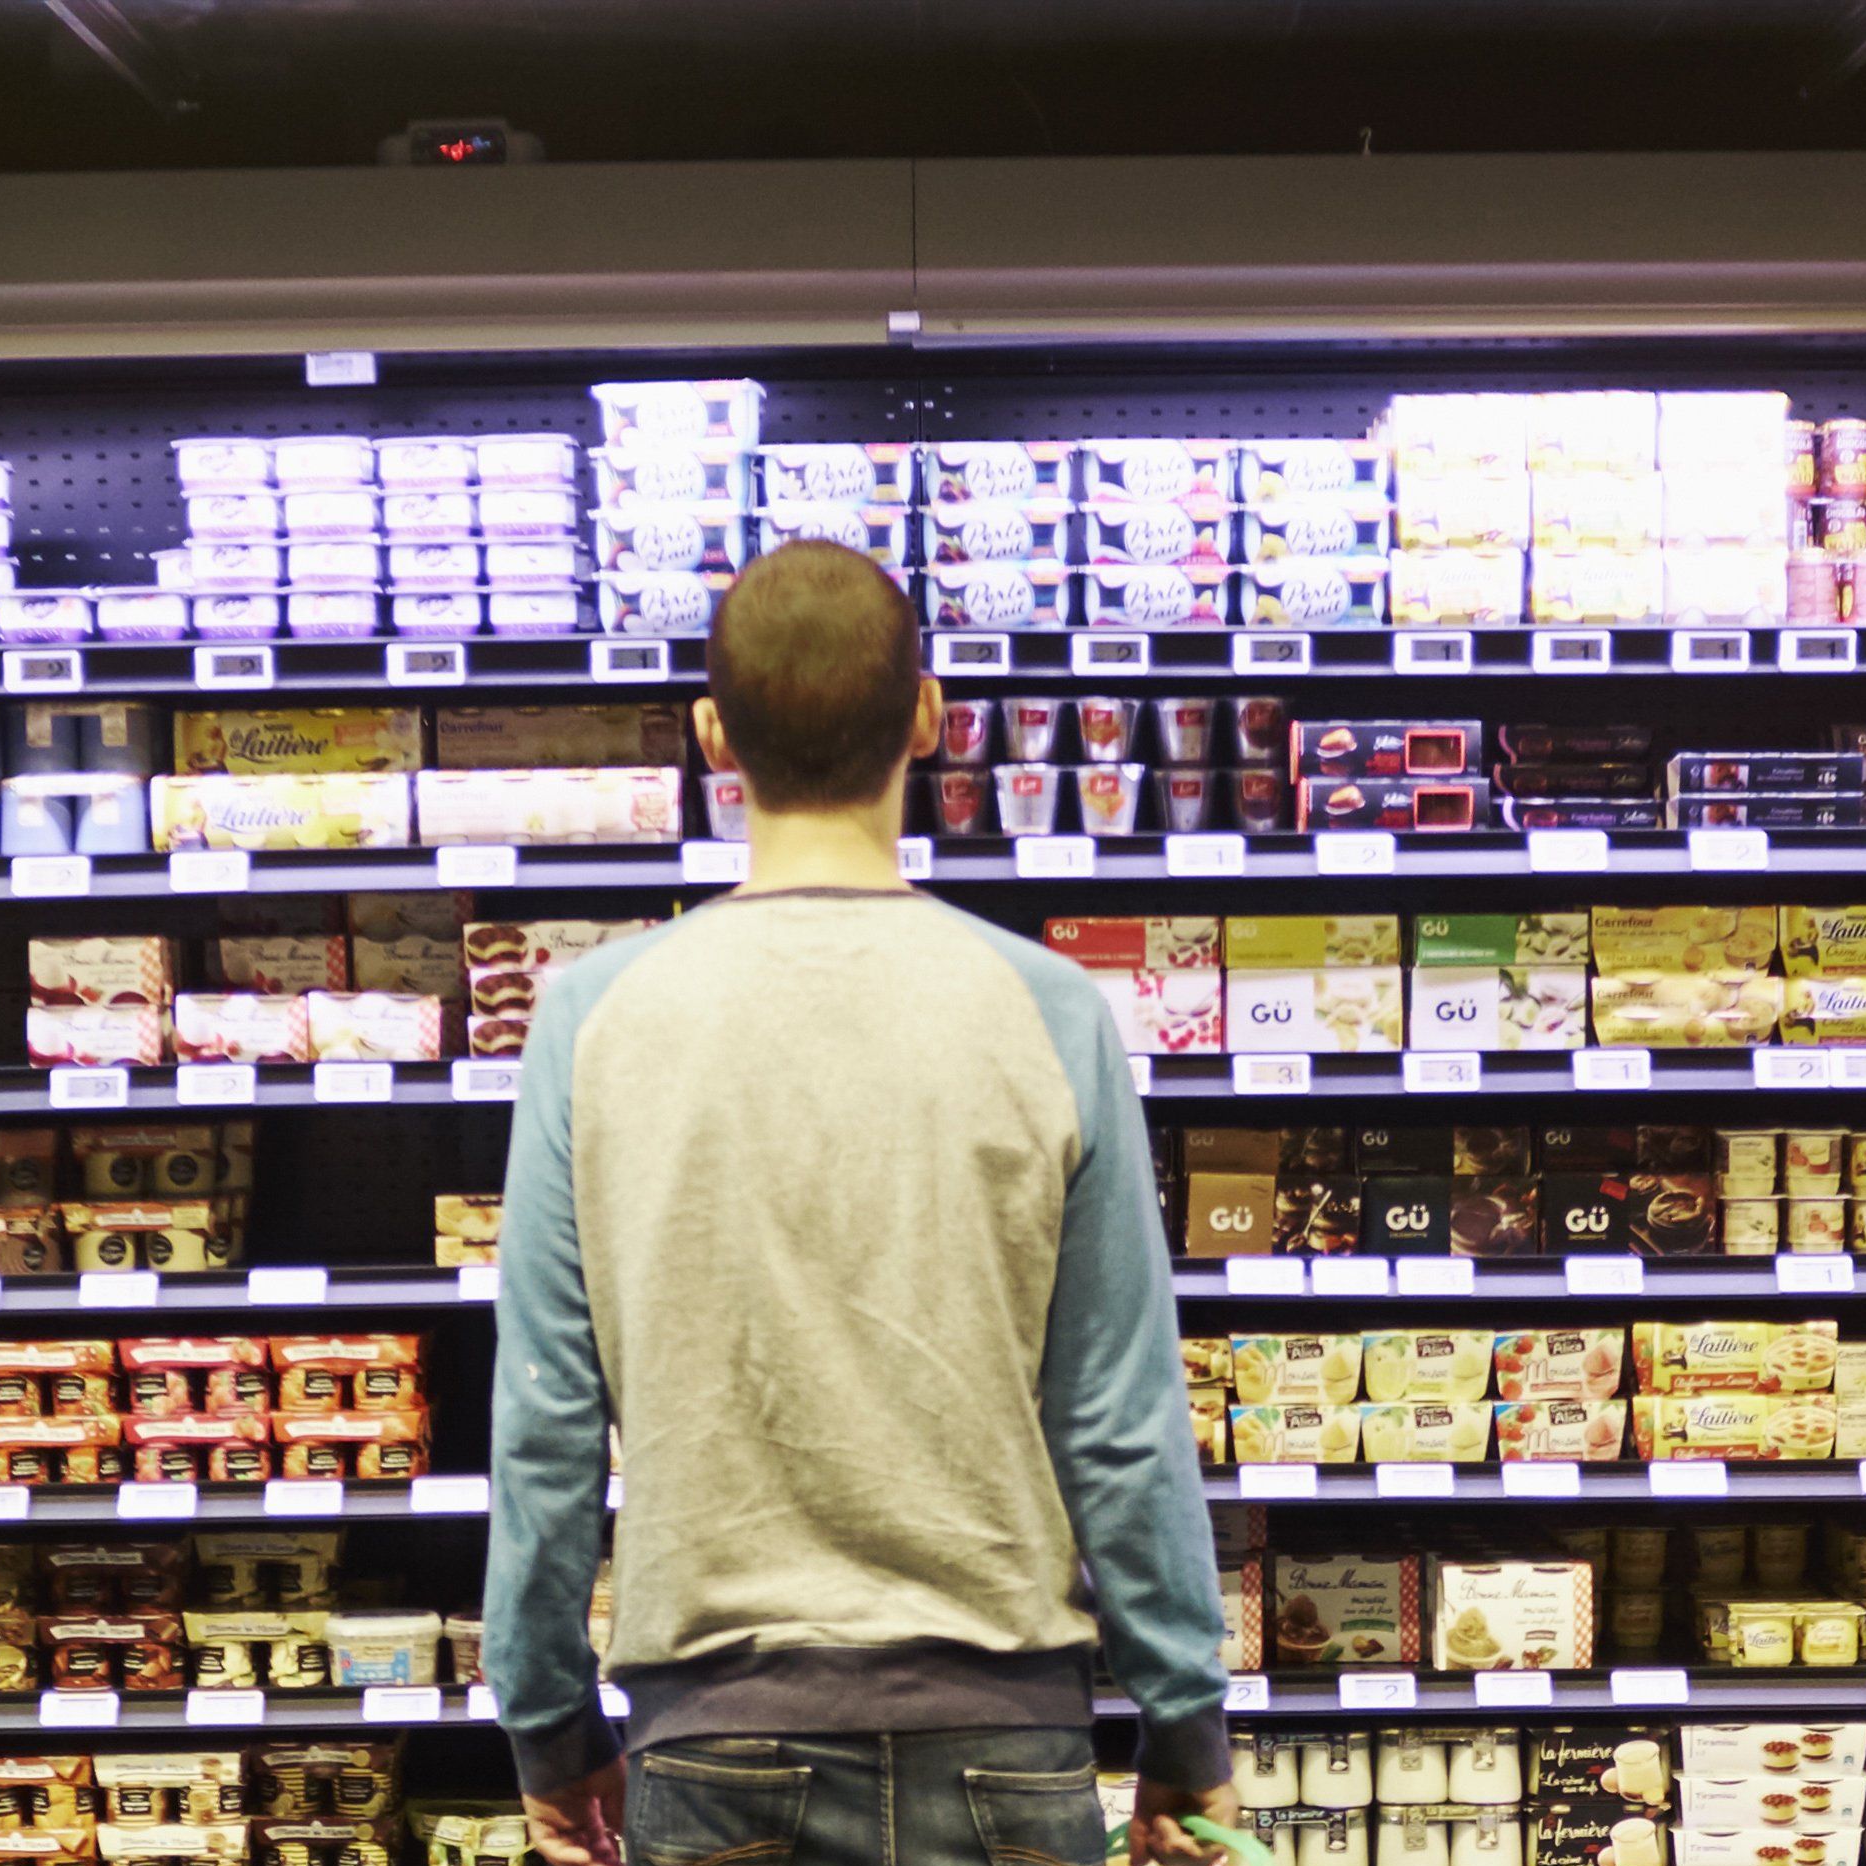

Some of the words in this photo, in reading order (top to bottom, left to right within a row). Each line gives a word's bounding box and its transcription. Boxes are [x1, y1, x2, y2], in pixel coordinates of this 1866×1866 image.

[231, 727, 330, 765] Laitière
[1051, 924, 1079, 941] GÜ
[1422, 922, 1450, 936] GÜ
[1595, 918, 1653, 928] Carrefour
[1250, 1002, 1292, 1023] GÜ
[1436, 1000, 1478, 1021] GÜ
[1361, 1131, 1388, 1147] GÜ
[1545, 1131, 1571, 1145] GÜ
[1208, 1202, 1254, 1233] GÜ
[1385, 1204, 1430, 1232] GÜ
[1565, 1206, 1610, 1233] GÜ
[1692, 1331, 1759, 1358] Laitière
[1692, 1404, 1759, 1431] Laitière
[1289, 1566, 1332, 1589] Bonne
[1333, 1569, 1387, 1589] Maman
[1558, 1742, 1614, 1768] fermière
[1555, 1821, 1610, 1846] fermière
